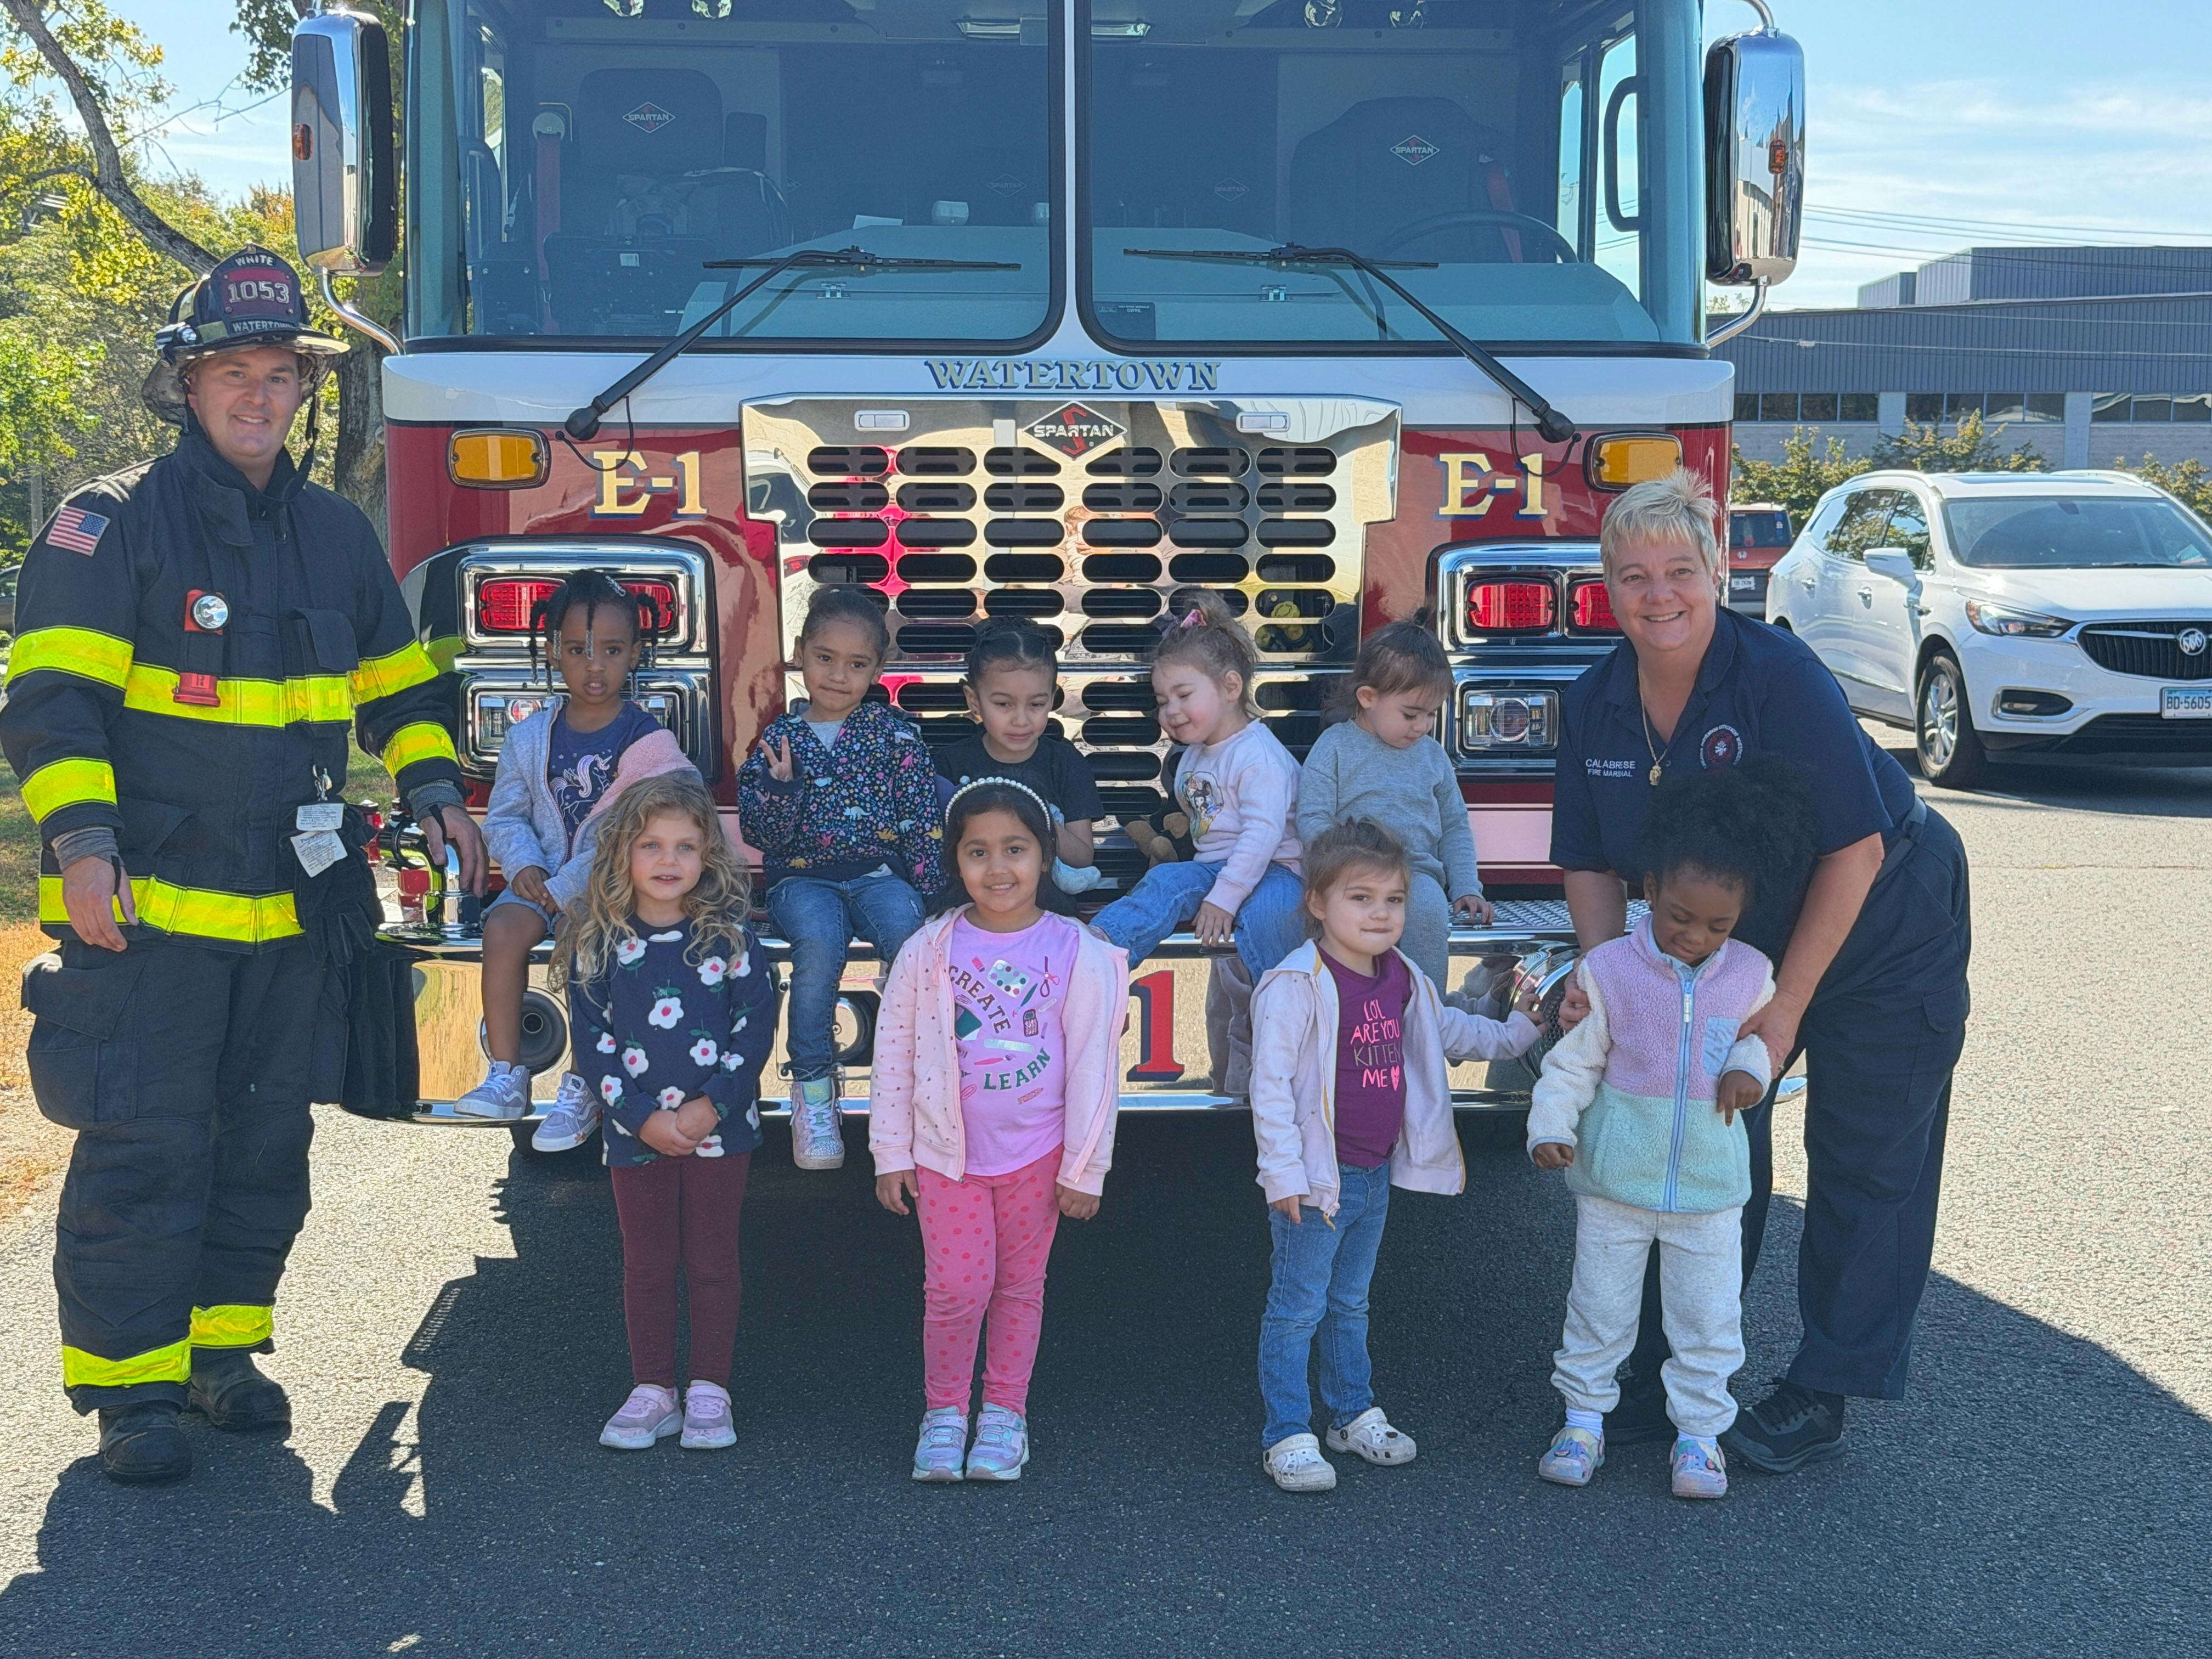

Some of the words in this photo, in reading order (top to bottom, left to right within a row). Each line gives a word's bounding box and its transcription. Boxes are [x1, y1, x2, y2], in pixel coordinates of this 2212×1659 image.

[235, 255, 274, 266] WHITE
[228, 281, 290, 303] 1053
[924, 360, 1222, 391] WATERTOWN
[1034, 424, 1114, 438] SPARTAN
[590, 450, 707, 519] E-1
[1434, 453, 1548, 519] E-1
[1585, 759, 1636, 769] CALABRESE
[949, 964, 1012, 1034] CREATE
[1363, 999, 1386, 1022] LOL
[1350, 1022, 1381, 1045] ARE
[1380, 1018, 1400, 1041] YOU
[1353, 1042, 1401, 1067] KITTEN
[983, 1047, 1051, 1091] LEARN
[1362, 1068, 1389, 1088] ME
